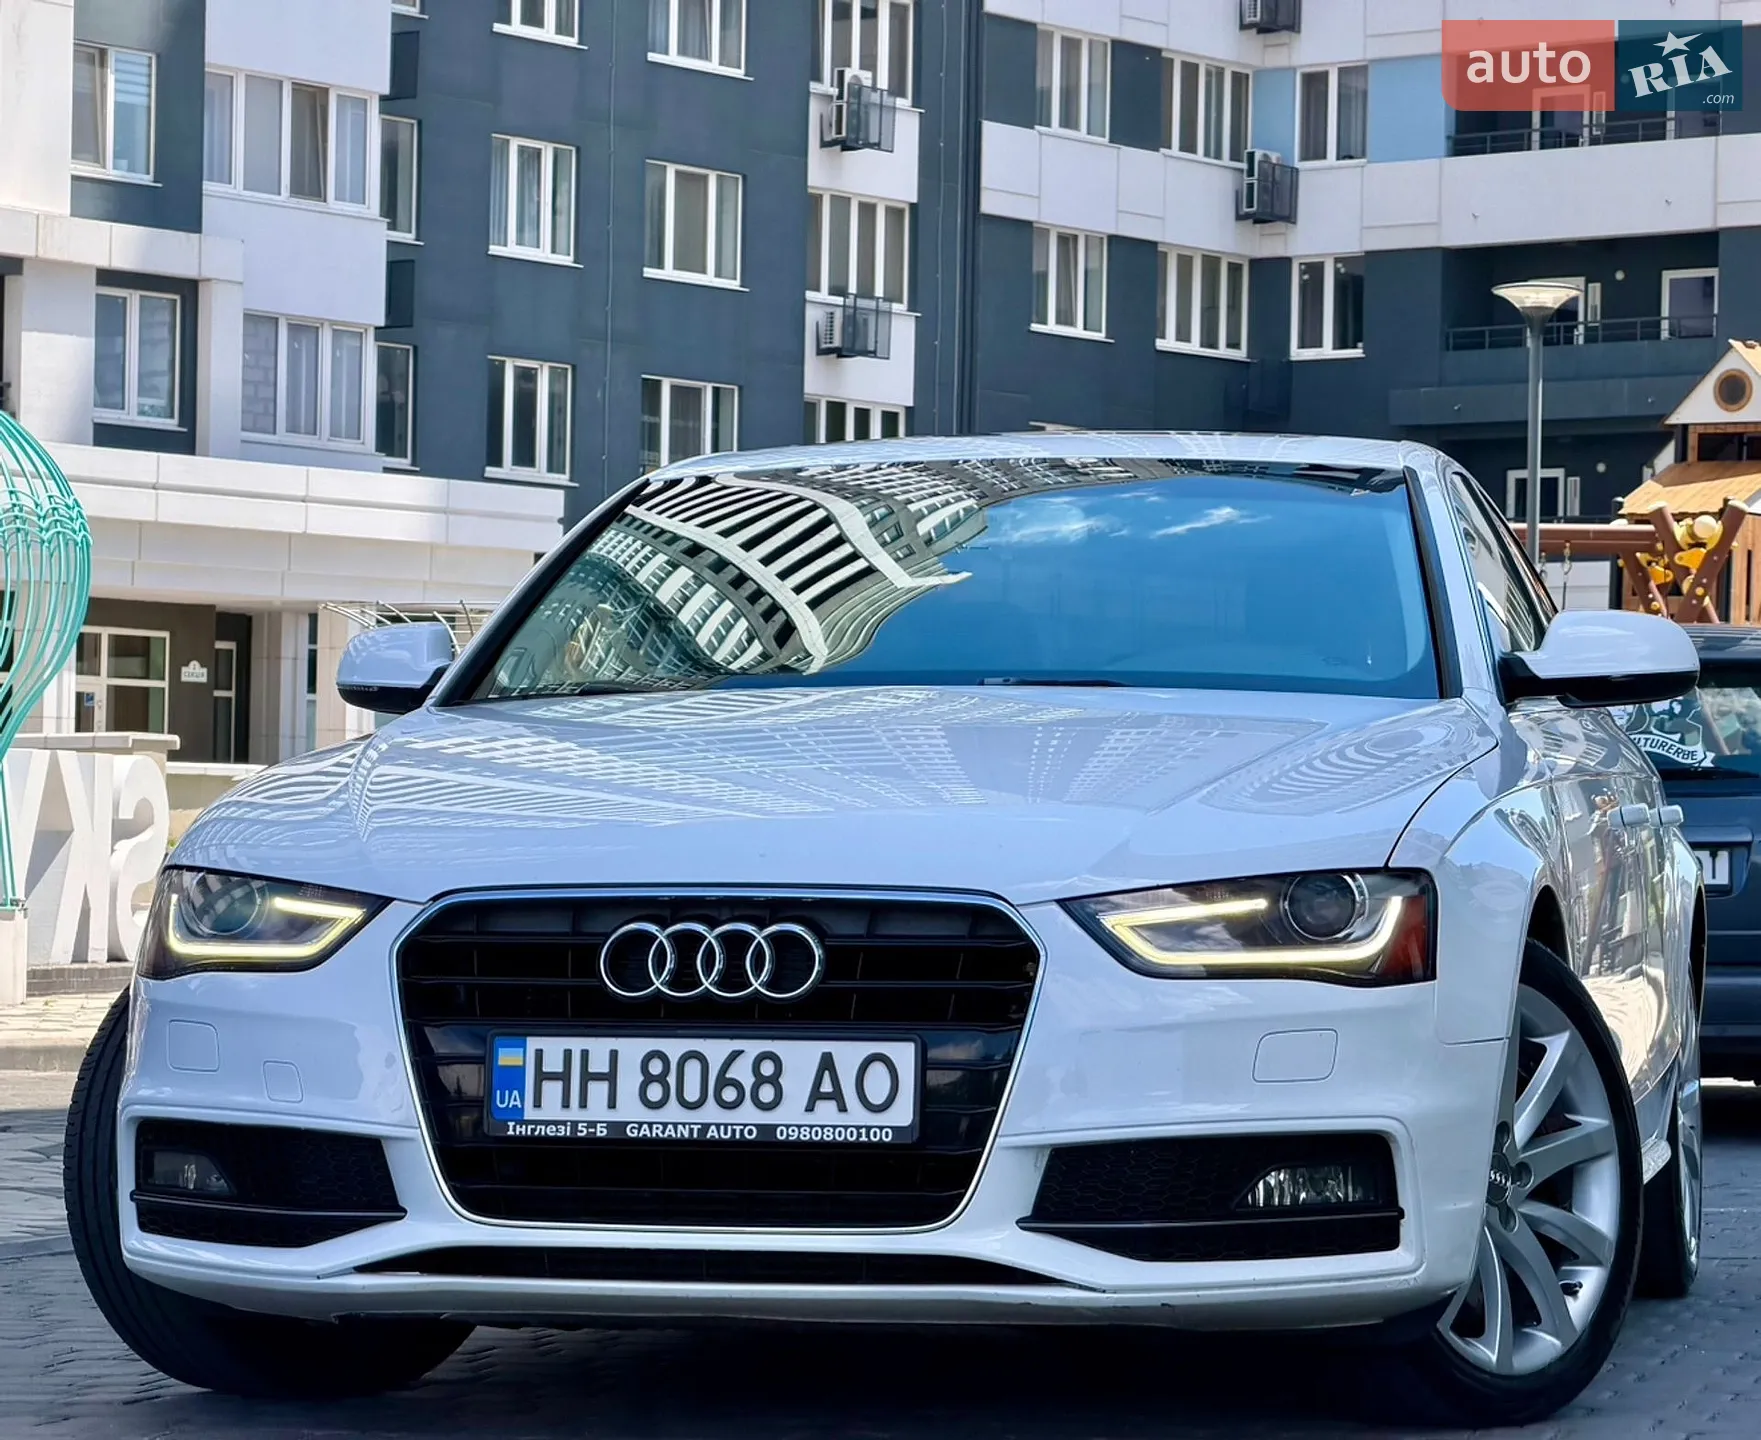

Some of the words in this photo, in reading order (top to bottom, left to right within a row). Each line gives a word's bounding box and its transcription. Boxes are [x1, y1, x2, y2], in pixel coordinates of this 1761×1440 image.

[532, 1048, 619, 1110] HH
[638, 1049, 784, 1112] 8068
[804, 1051, 900, 1113] AO
[496, 1089, 522, 1109] UA
[506, 1121, 572, 1137] Інглезі
[626, 1123, 702, 1139] GARANT
[706, 1124, 758, 1140] AUTO
[776, 1125, 893, 1142] 0980800100
